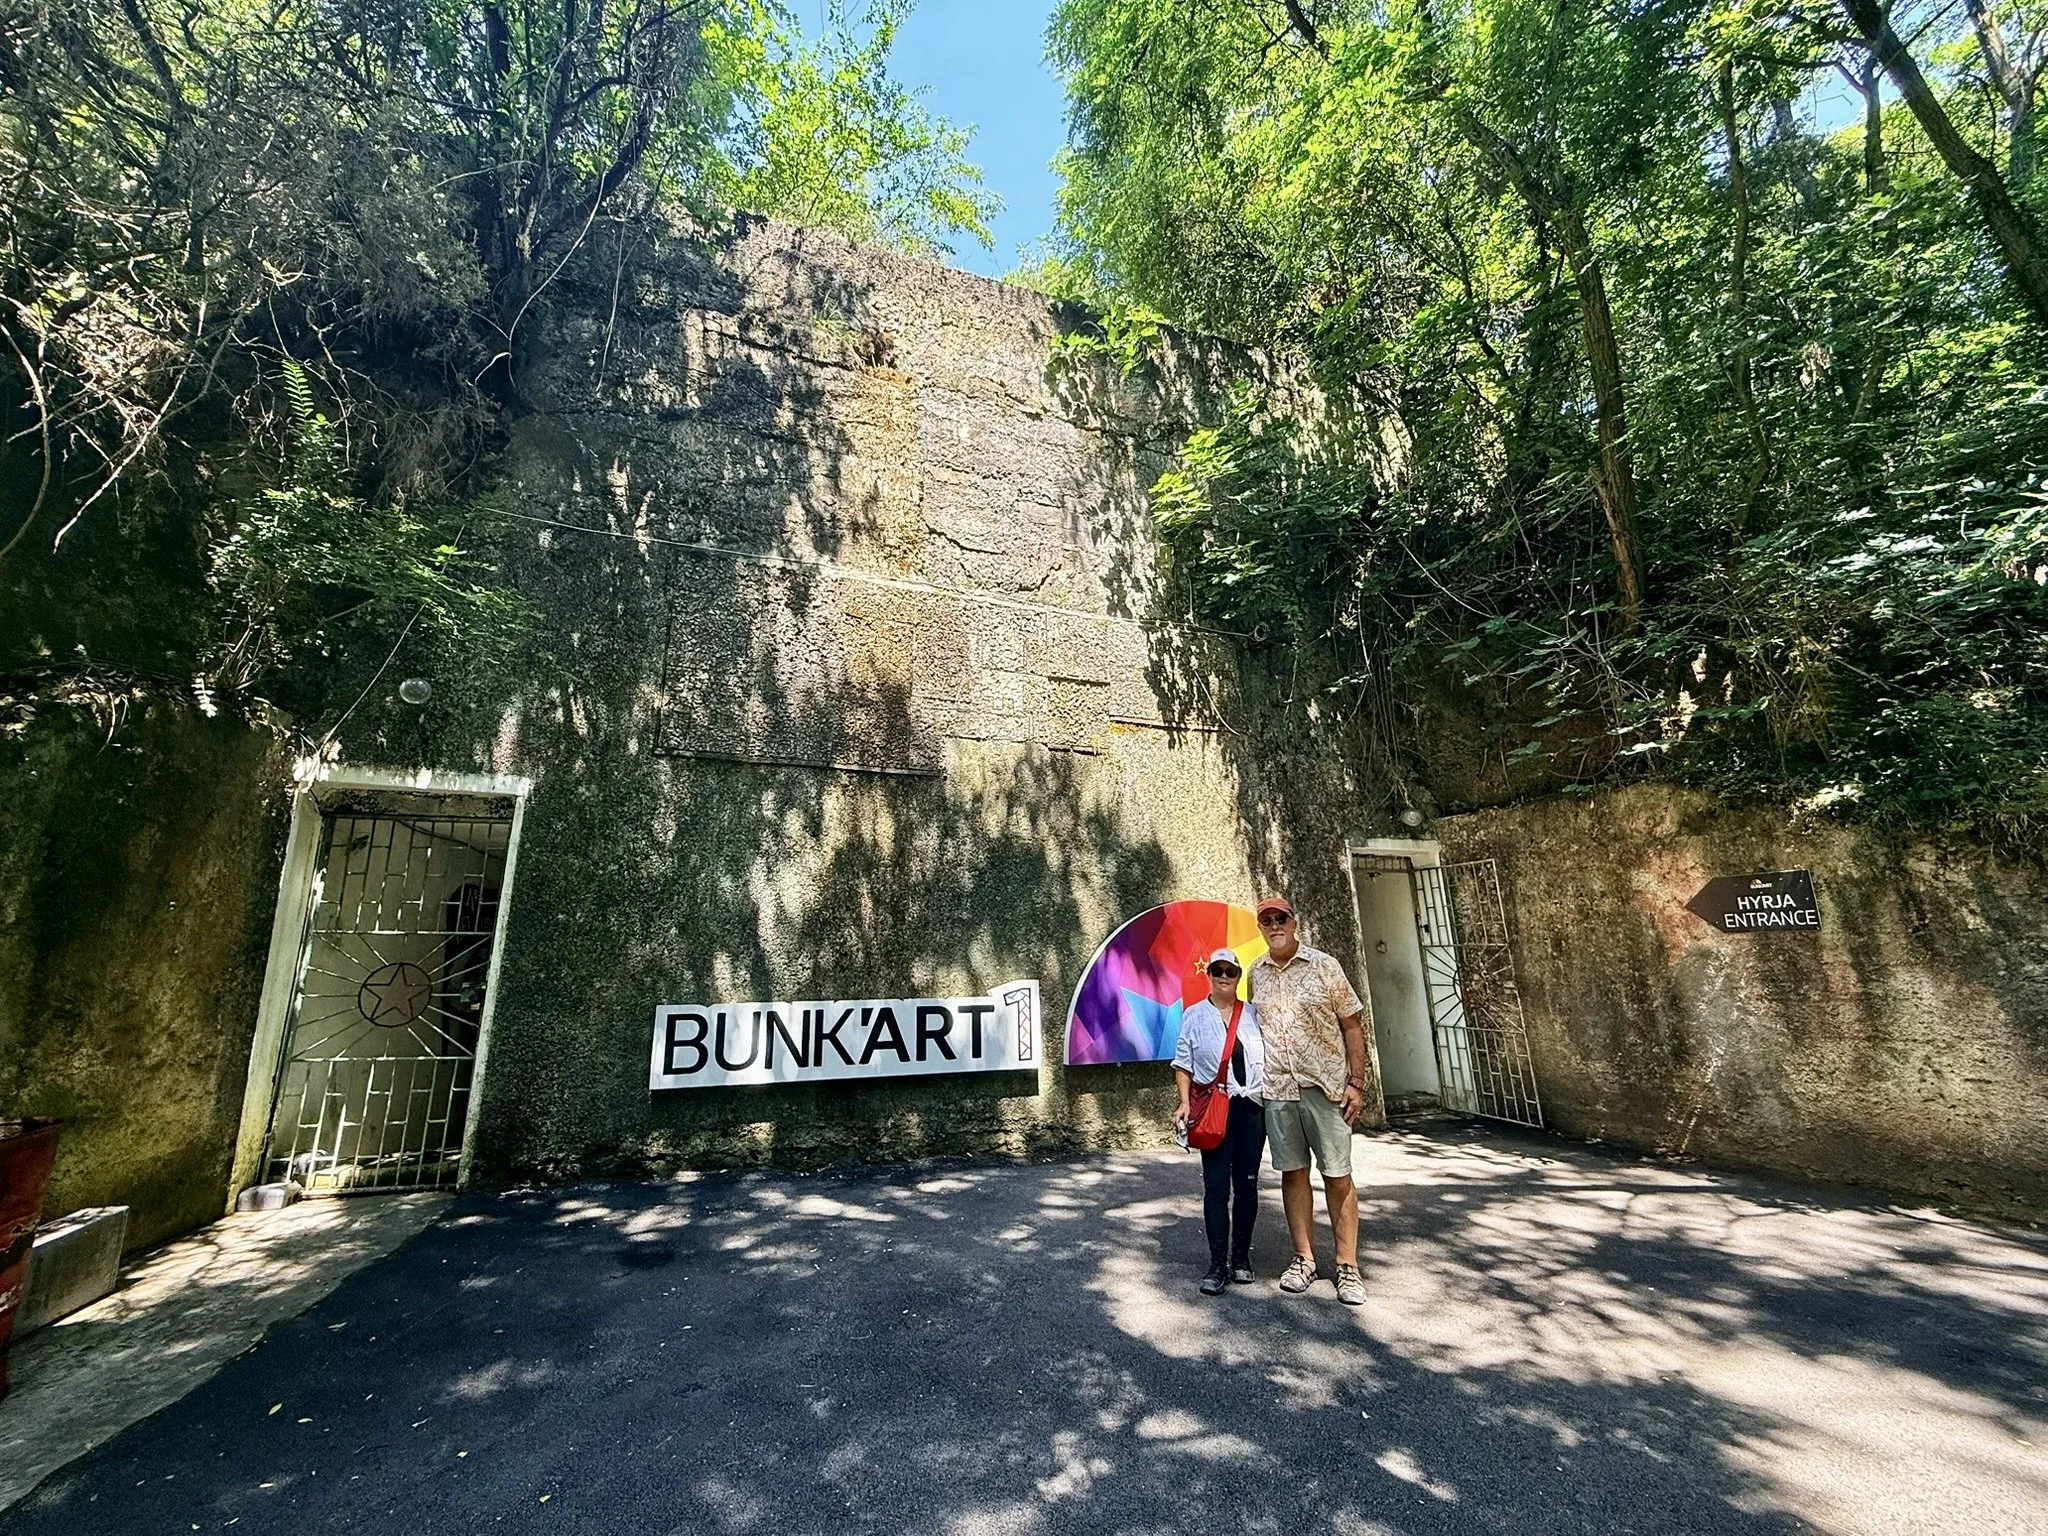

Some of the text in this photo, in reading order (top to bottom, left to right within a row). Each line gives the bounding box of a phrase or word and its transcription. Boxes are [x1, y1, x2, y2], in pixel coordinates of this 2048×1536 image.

[1737, 893, 1796, 910] HYRJA
[1724, 909, 1818, 928] ENTRANCE
[662, 987, 1032, 1076] BUNK'ART 1
